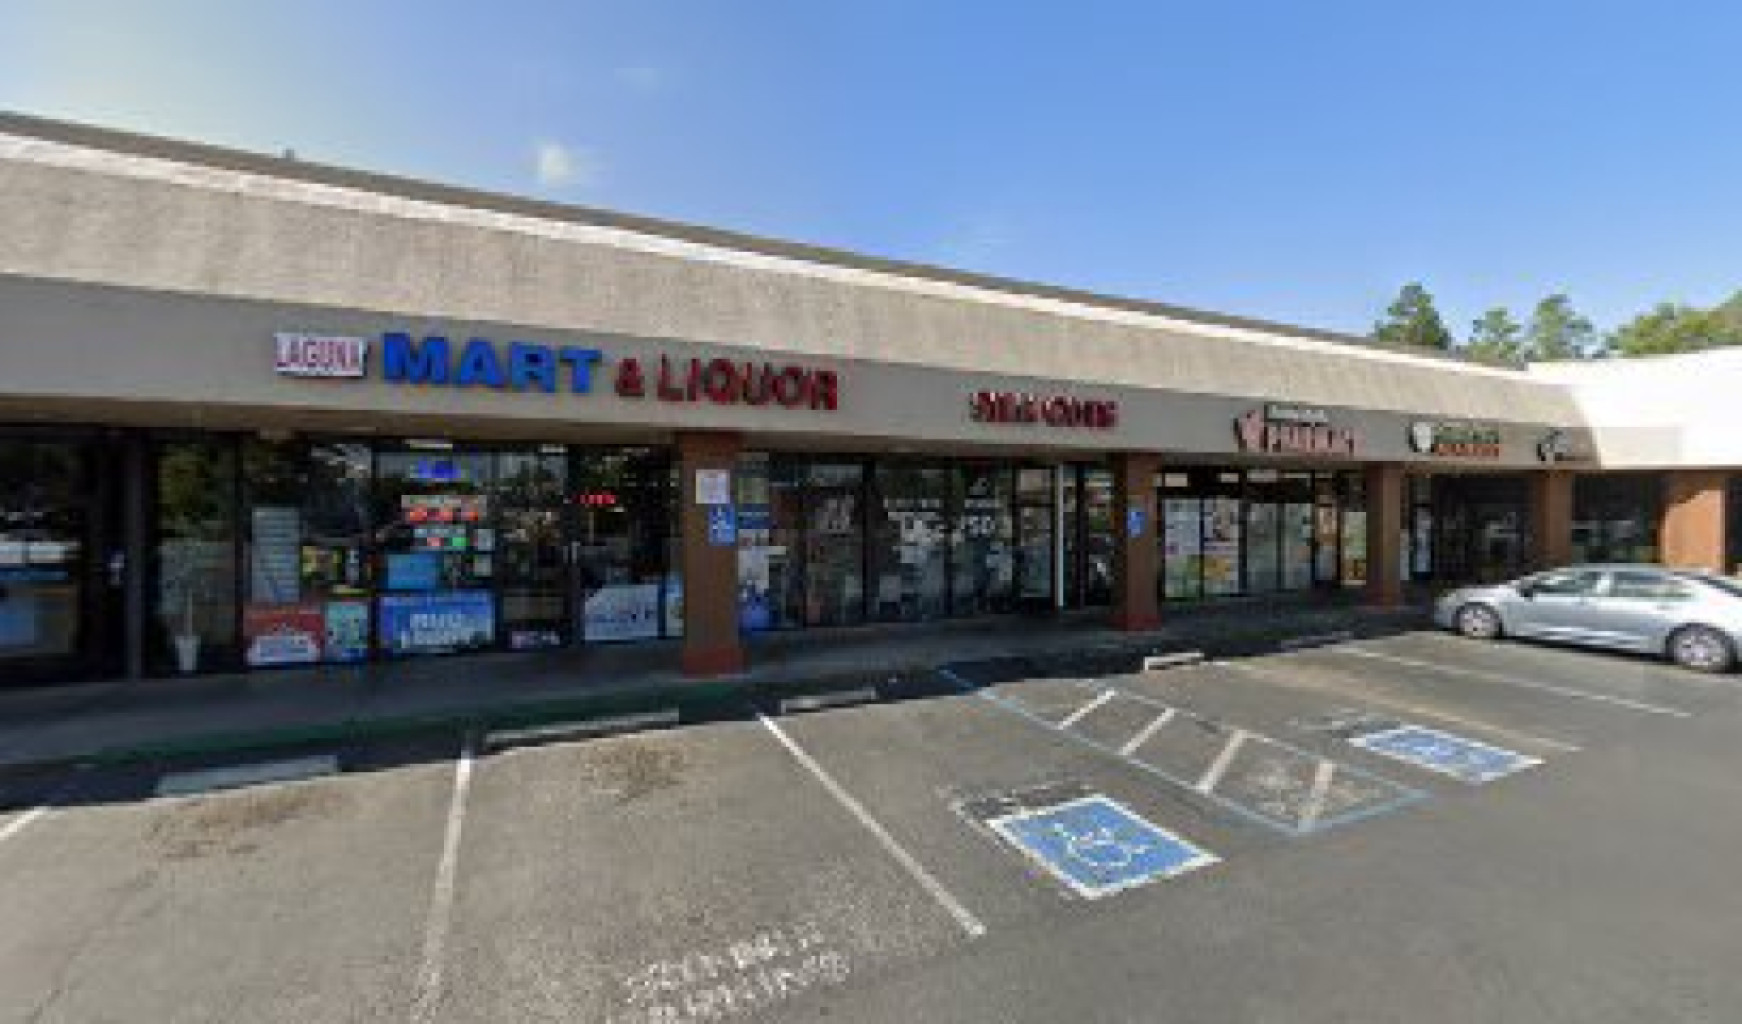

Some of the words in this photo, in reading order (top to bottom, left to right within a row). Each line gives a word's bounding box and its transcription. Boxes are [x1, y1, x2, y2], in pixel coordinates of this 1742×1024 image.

[382, 332, 601, 392] MART
[615, 357, 645, 397] &
[657, 354, 838, 411] LIQUOR
